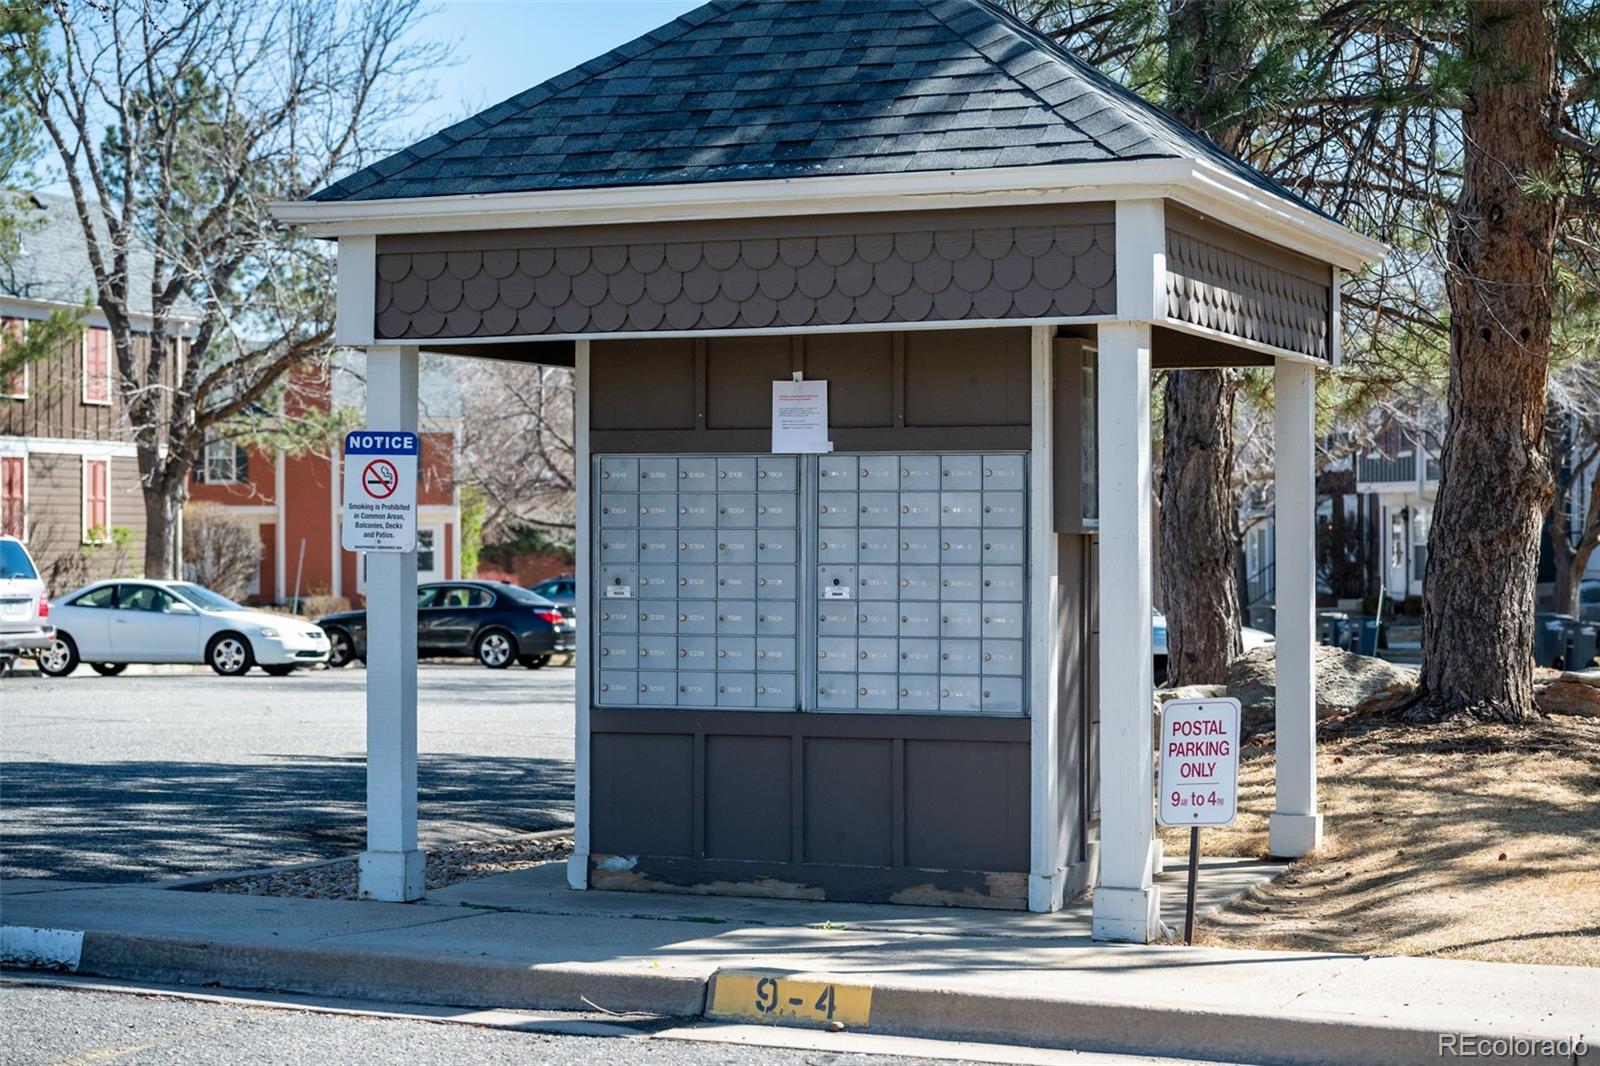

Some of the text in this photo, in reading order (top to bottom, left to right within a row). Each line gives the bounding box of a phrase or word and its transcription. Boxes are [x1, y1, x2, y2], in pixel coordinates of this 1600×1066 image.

[349, 436, 413, 449] NOTICE
[348, 503, 374, 511] Smoking
[381, 503, 410, 511] Prohibited
[360, 512, 386, 520] Common
[387, 512, 405, 520] Areas,
[1172, 720, 1227, 736] POSTAL
[1168, 741, 1229, 757] PARKING
[1180, 762, 1216, 778] ONLY
[1191, 792, 1205, 806] to
